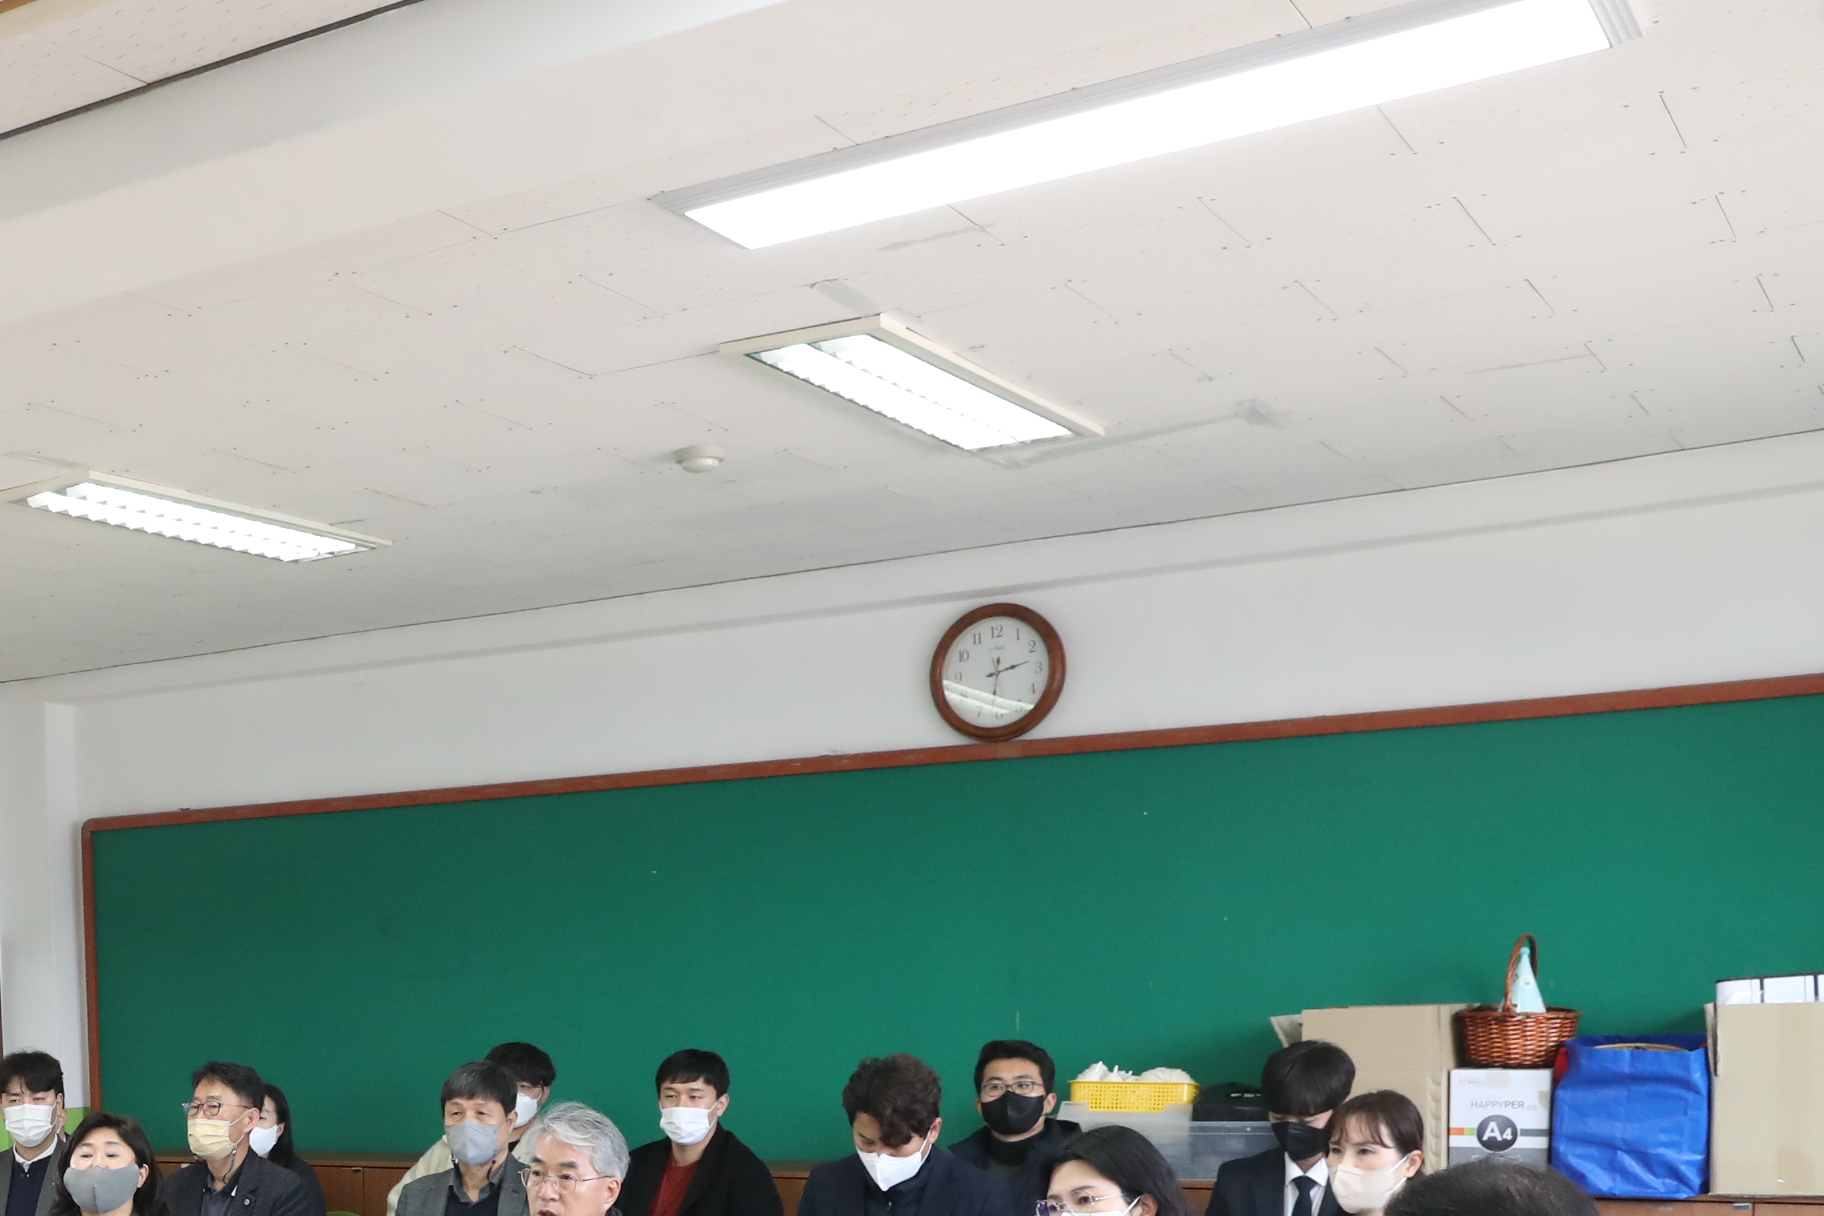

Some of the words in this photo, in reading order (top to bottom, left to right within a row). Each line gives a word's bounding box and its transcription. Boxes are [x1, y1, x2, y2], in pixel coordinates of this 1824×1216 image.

[990, 624, 1004, 639] 12
[1015, 628, 1021, 641] 1
[972, 632, 982, 645] 11
[1028, 639, 1037, 653] 2
[958, 649, 969, 663] 10
[1034, 661, 1043, 674] 3
[954, 671, 962, 682] 9
[1029, 682, 1036, 695] 4
[976, 705, 983, 718] 7
[1470, 1100, 1525, 1109] HAPPYPER
[1482, 1121, 1513, 1141] A4
